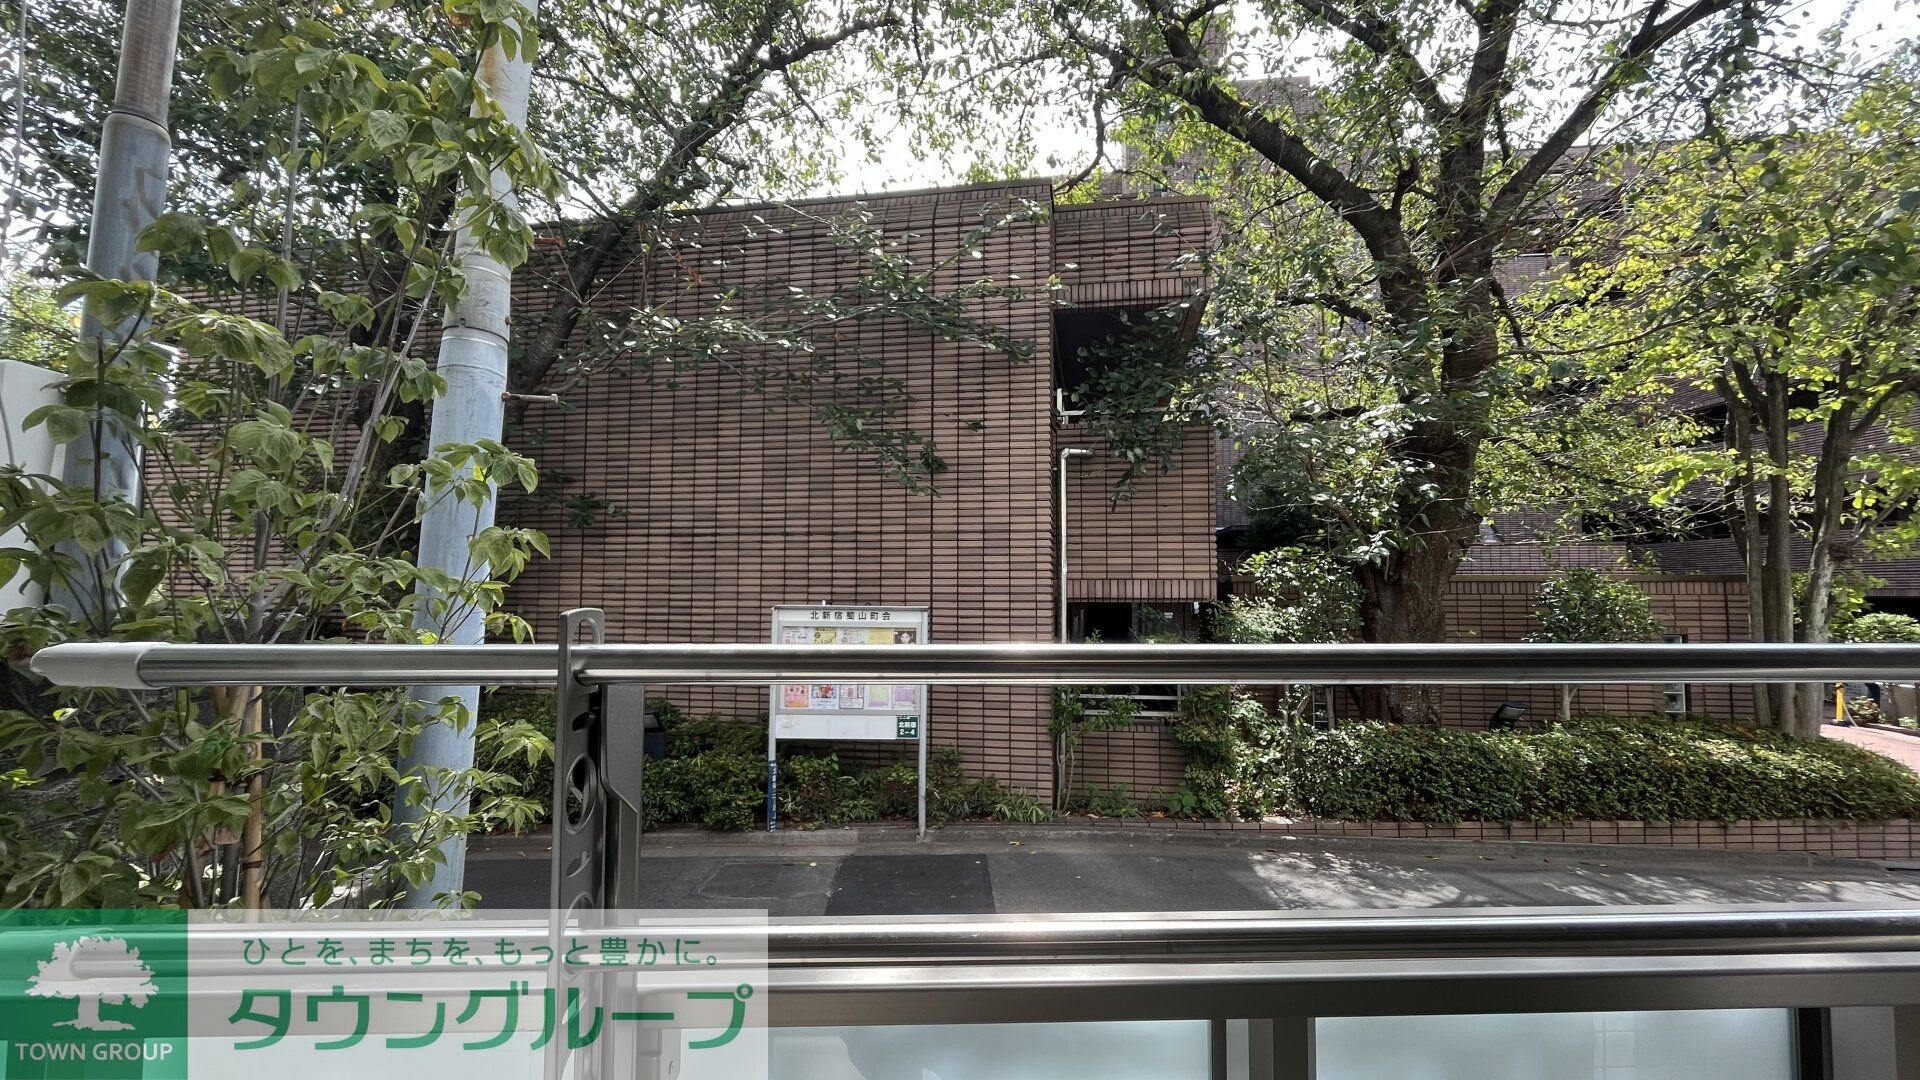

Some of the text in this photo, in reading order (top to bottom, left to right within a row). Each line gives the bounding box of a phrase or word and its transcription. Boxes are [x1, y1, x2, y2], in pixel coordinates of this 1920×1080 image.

[810, 611, 891, 621] 北新宿蜀山町会
